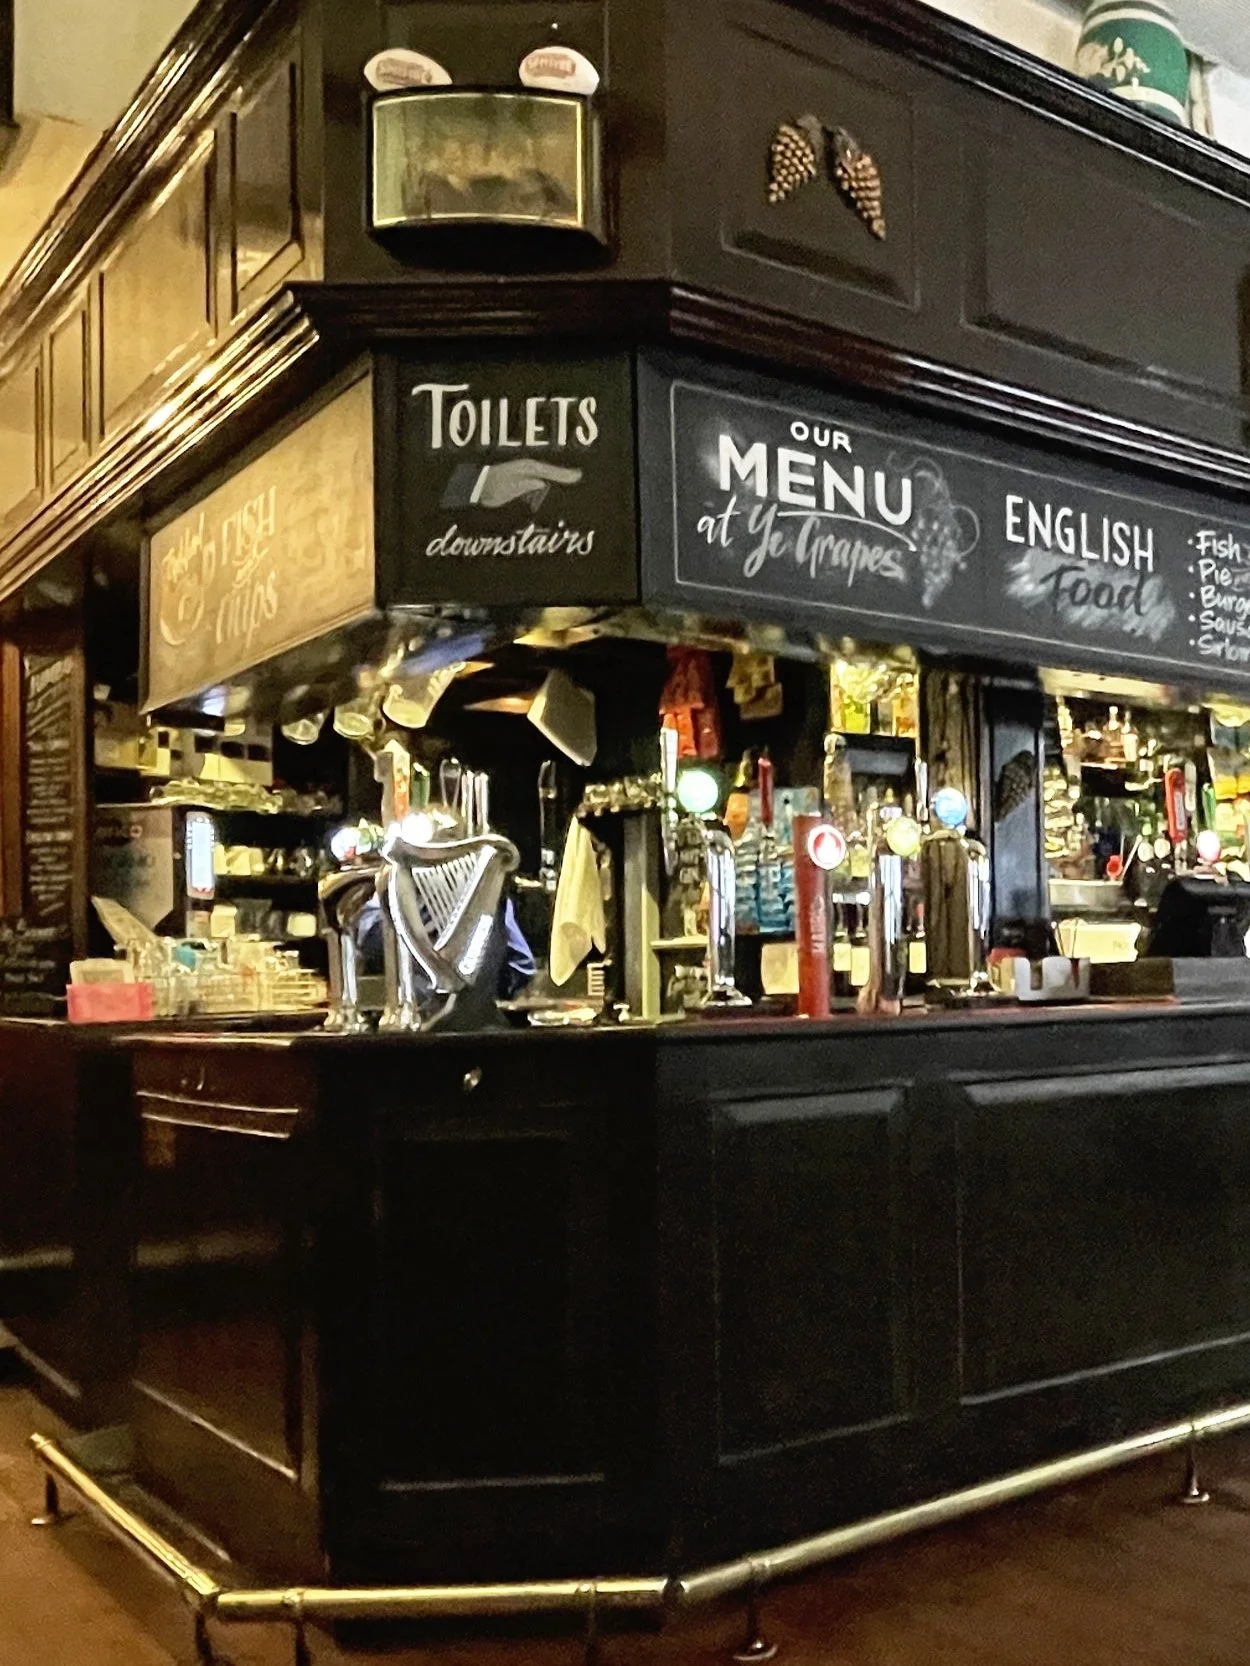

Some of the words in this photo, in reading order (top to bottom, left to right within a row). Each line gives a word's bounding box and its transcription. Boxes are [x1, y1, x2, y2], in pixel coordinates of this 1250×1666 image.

[412, 383, 599, 449] TOILETS
[790, 421, 852, 454] OUR
[718, 434, 912, 526] MENU
[425, 519, 595, 557] downstairs
[697, 495, 741, 548] at
[795, 516, 905, 587] Grapes
[1006, 494, 1154, 573] ENGLISH
[1196, 530, 1241, 563] Fish
[1039, 563, 1145, 617] Food
[1199, 559, 1232, 586] Pie
